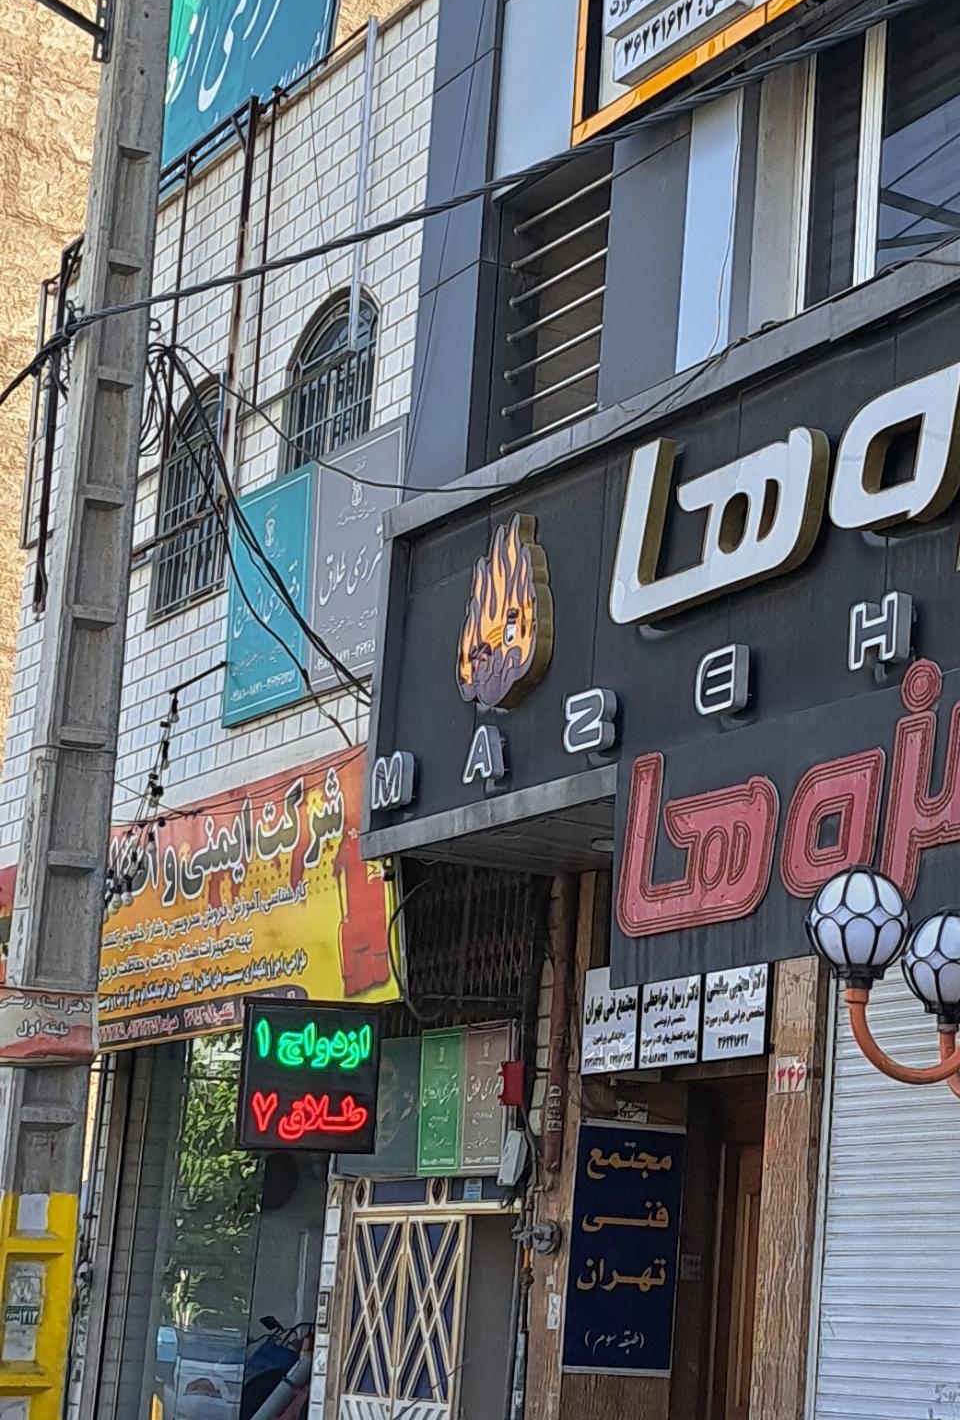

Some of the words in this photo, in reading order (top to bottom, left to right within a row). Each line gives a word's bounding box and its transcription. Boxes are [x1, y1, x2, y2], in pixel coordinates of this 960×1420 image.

[254, 766, 346, 869] شرکت
[180, 795, 253, 900] ایمنی
[160, 844, 178, 908] و
[66, 997, 92, 1016] دفتر
[16, 1018, 40, 1039] اول
[42, 1020, 69, 1039] طبقه
[276, 1021, 372, 1070] ازدواج
[278, 1093, 369, 1142] طلاق
[585, 1141, 673, 1179] مجتمع
[581, 1200, 669, 1233] فنی
[575, 1258, 667, 1292] تهران
